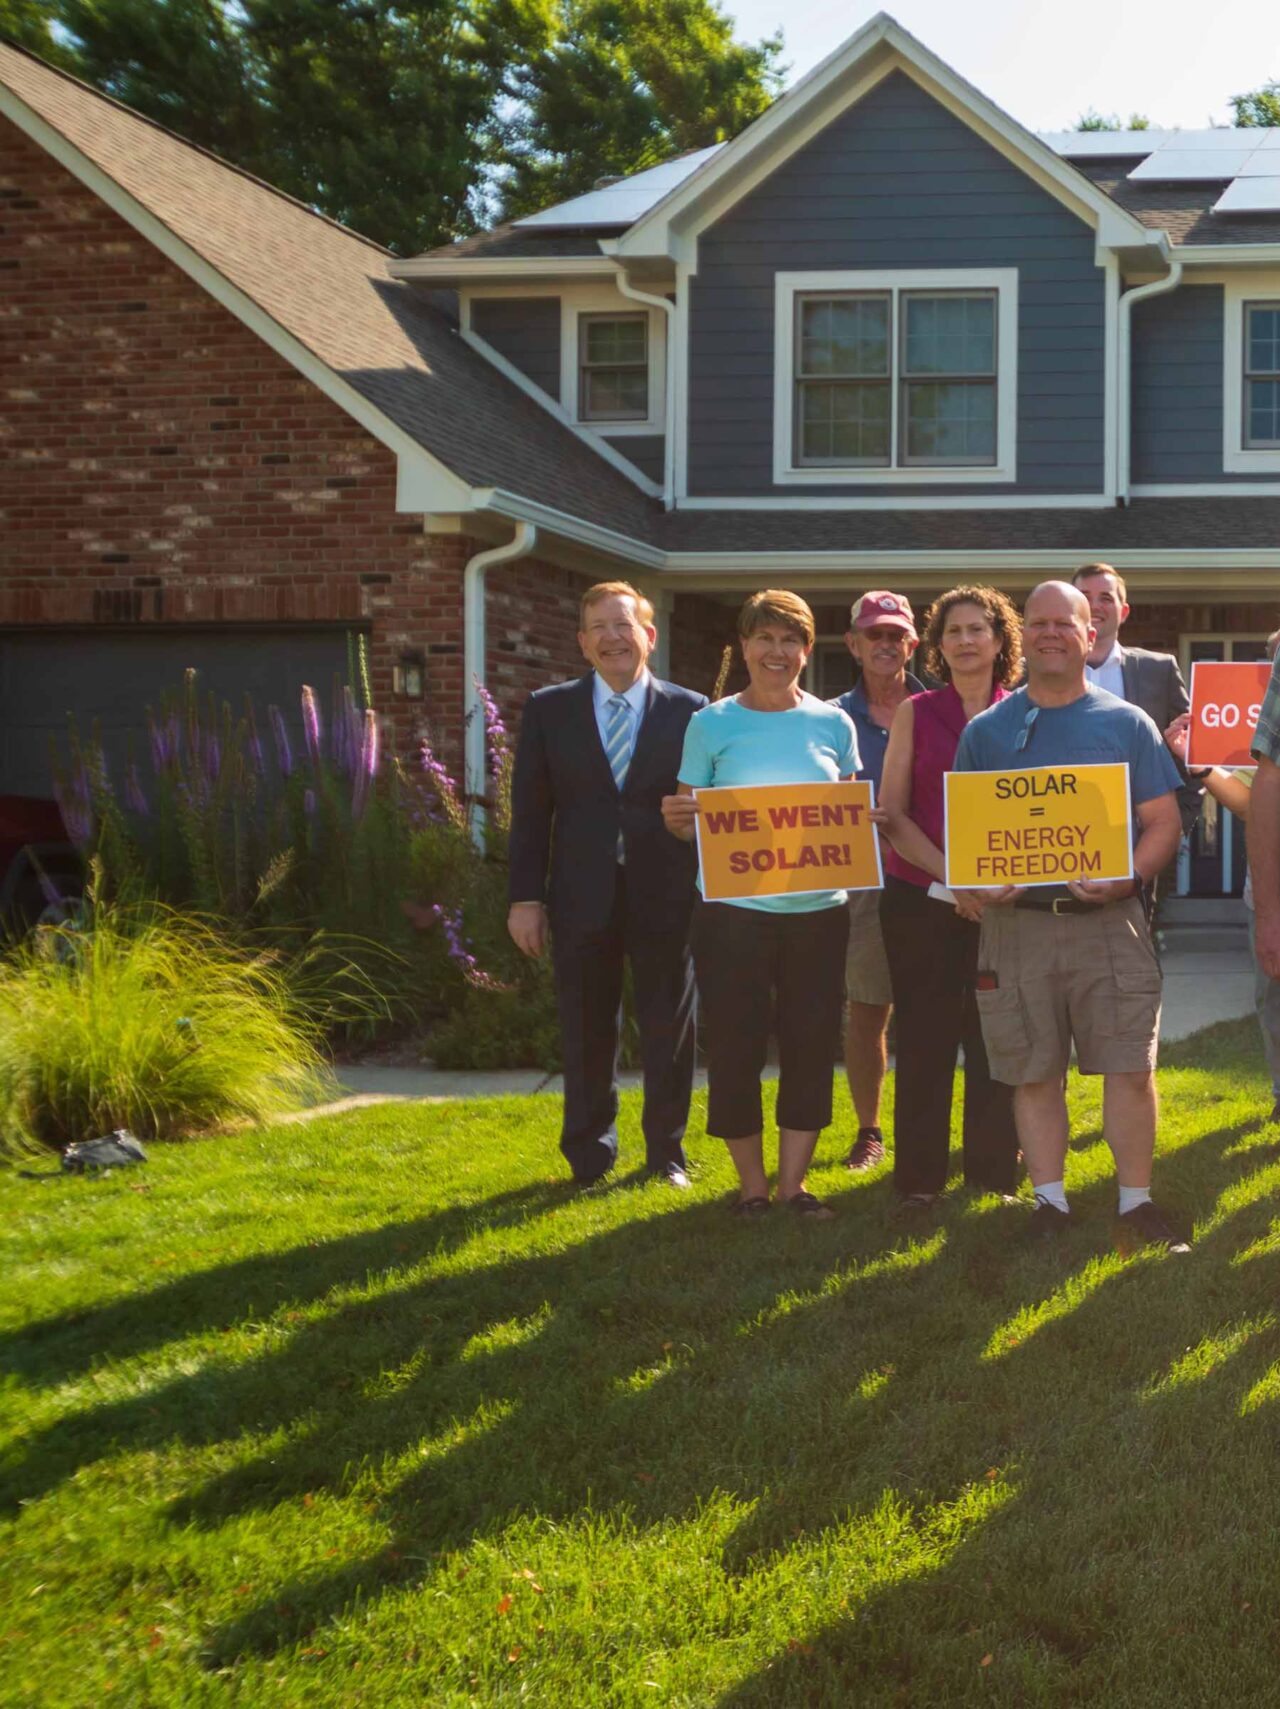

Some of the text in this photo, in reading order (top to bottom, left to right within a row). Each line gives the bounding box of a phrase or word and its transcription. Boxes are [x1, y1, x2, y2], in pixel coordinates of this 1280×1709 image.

[1200, 702, 1240, 729] GO
[995, 774, 1077, 799] SOLAR
[705, 803, 864, 834] WE WENT
[987, 825, 1091, 851] ENERGY
[729, 845, 852, 874] SOLAR!
[976, 851, 1102, 878] FREEDOM
